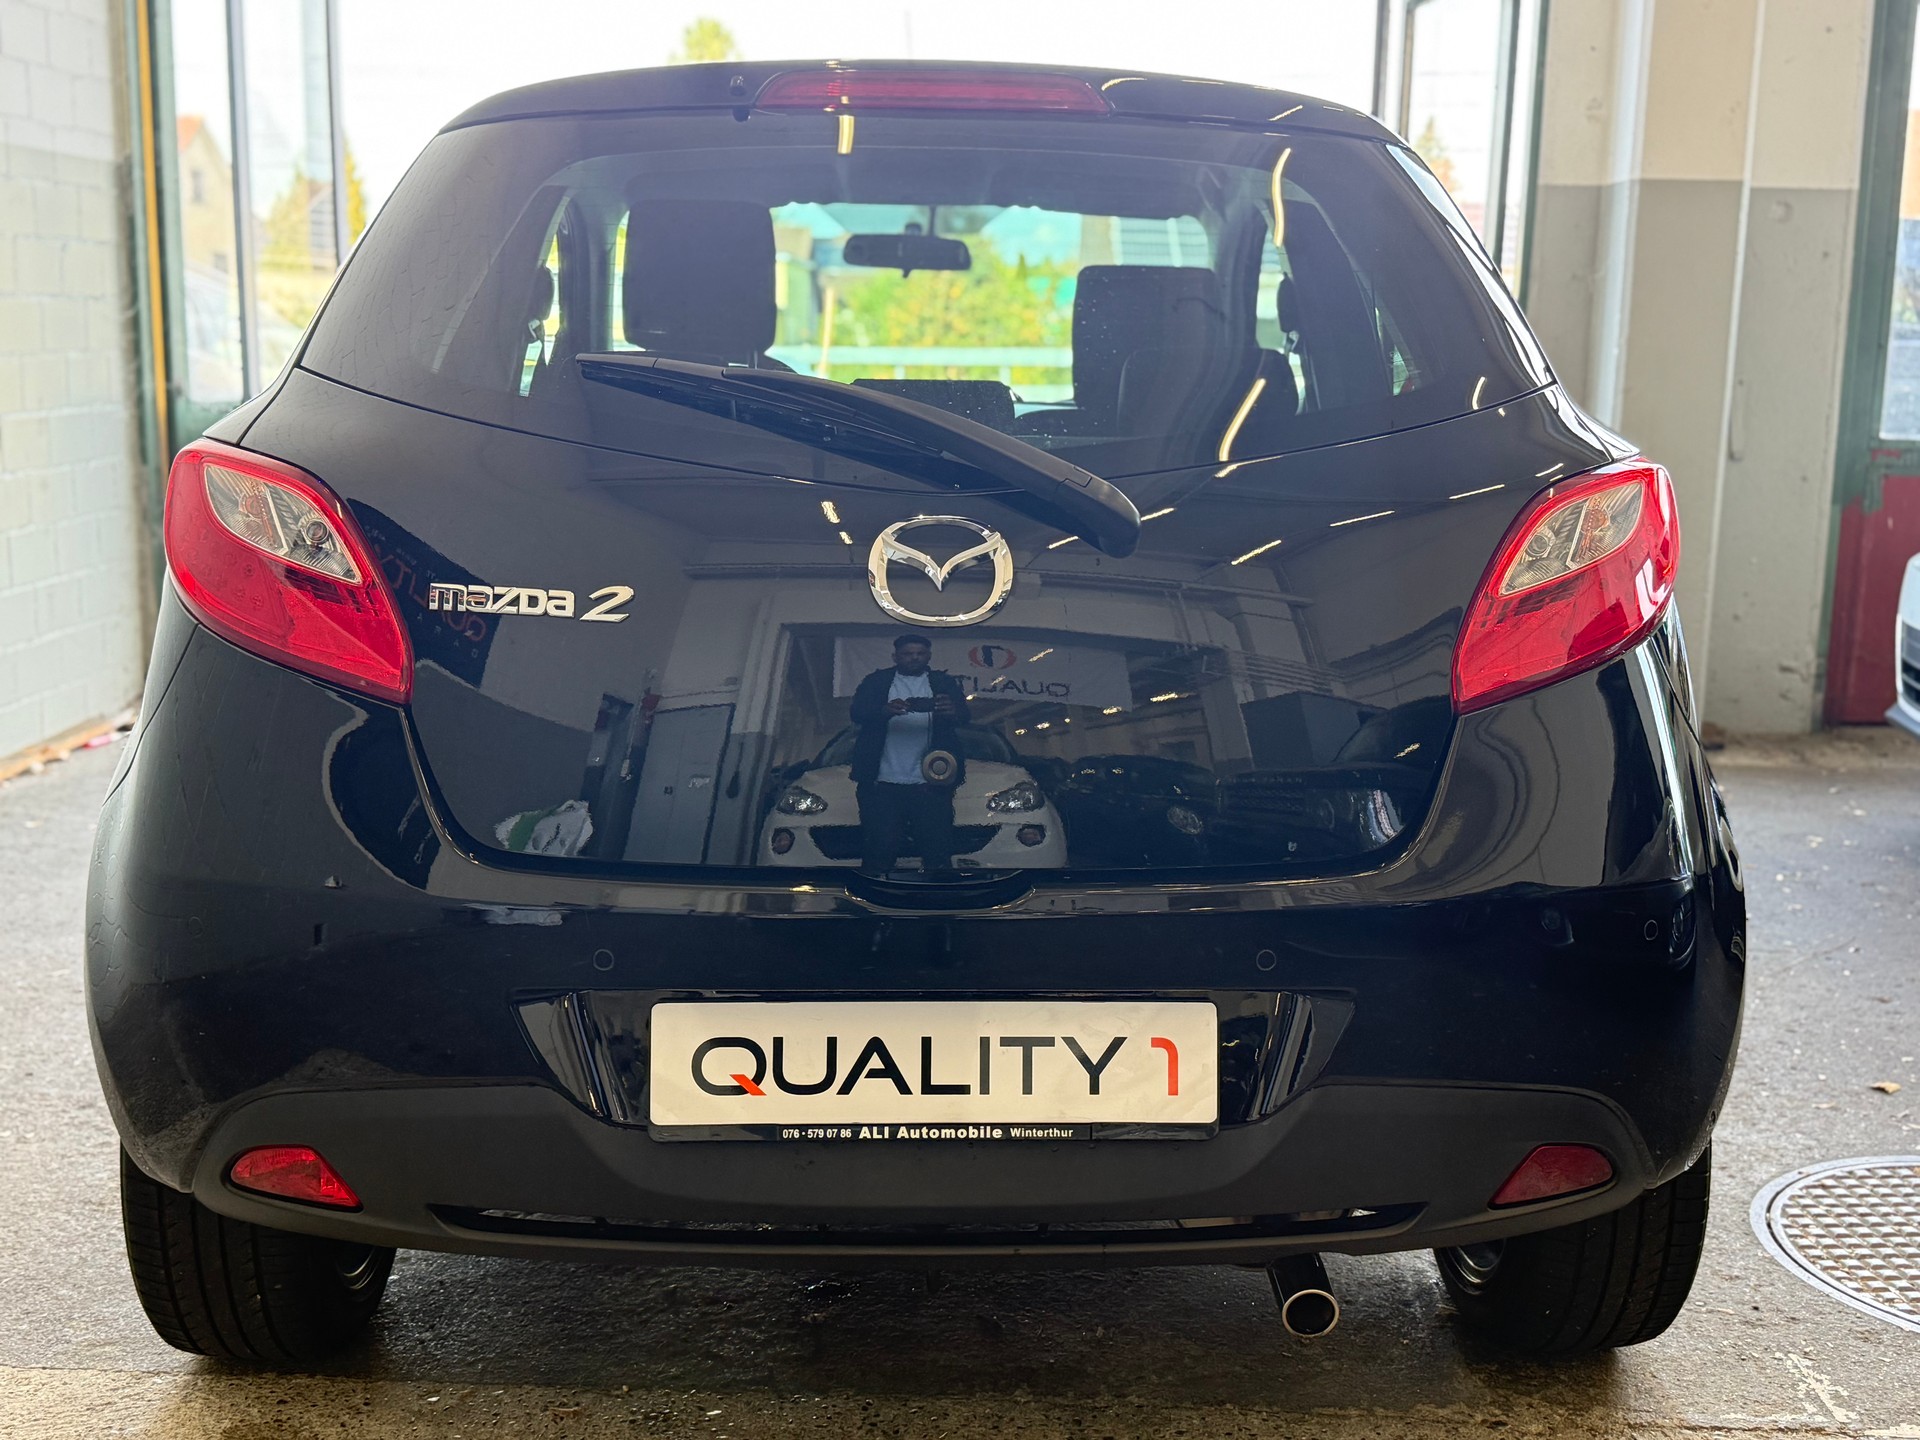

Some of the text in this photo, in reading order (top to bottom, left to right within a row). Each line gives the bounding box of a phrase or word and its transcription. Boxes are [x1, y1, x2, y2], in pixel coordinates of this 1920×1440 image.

[579, 585, 635, 623] 2
[691, 1036, 1179, 1097] QUALITY 1
[826, 1128, 838, 1139] 07
[840, 1128, 852, 1139] 86
[859, 1126, 890, 1139] ALI
[897, 1126, 1003, 1139] Automobile
[1009, 1127, 1074, 1138] Winterthur
